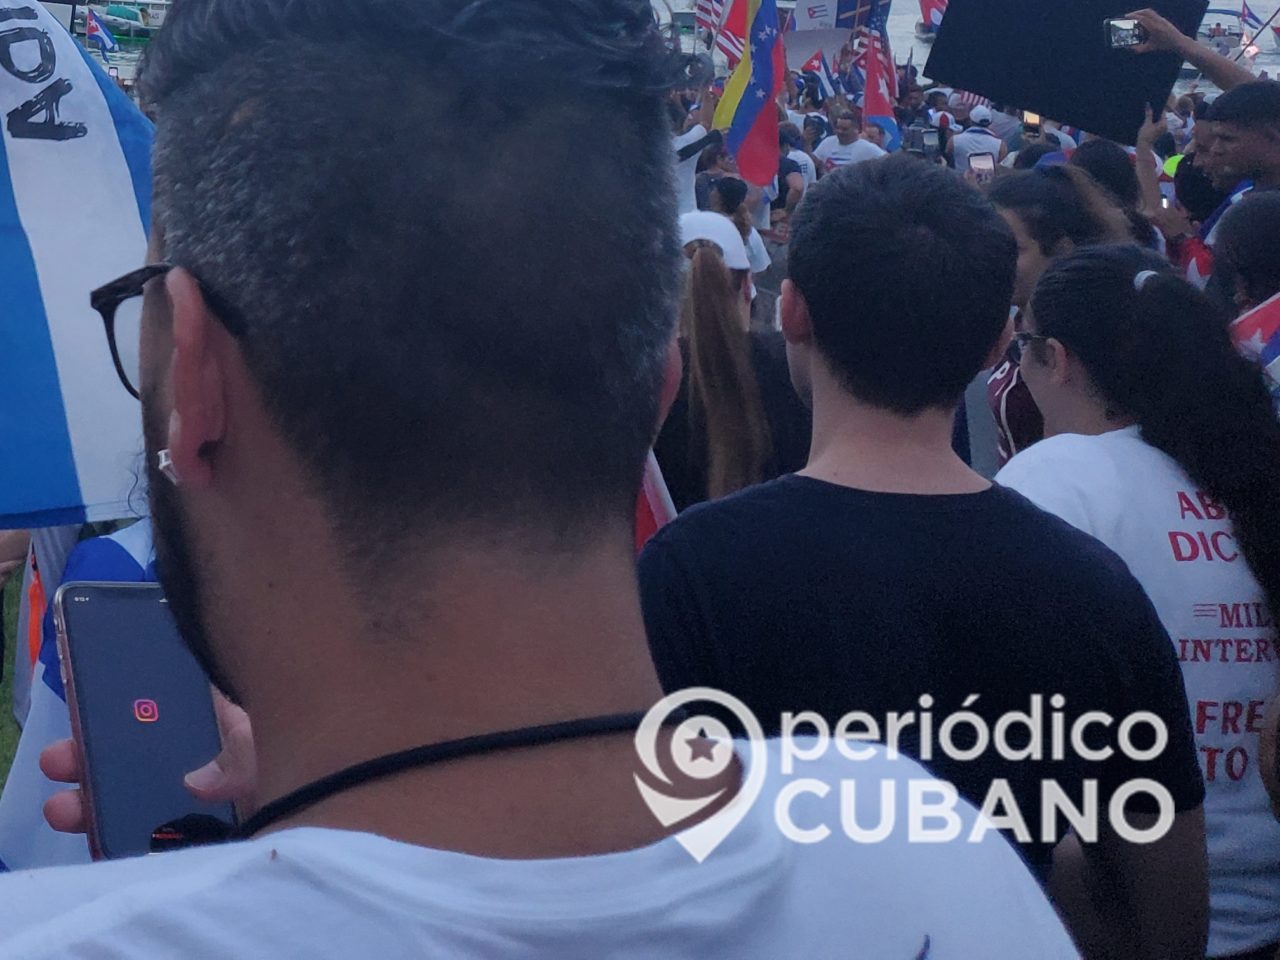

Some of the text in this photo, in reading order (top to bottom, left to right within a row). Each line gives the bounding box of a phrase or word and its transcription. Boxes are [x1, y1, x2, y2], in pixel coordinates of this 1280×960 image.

[1177, 491, 1228, 520] AB
[1168, 531, 1239, 562] DIC
[1219, 603, 1269, 629] MIL
[1195, 700, 1266, 735] FRE
[1200, 746, 1249, 782] TO
